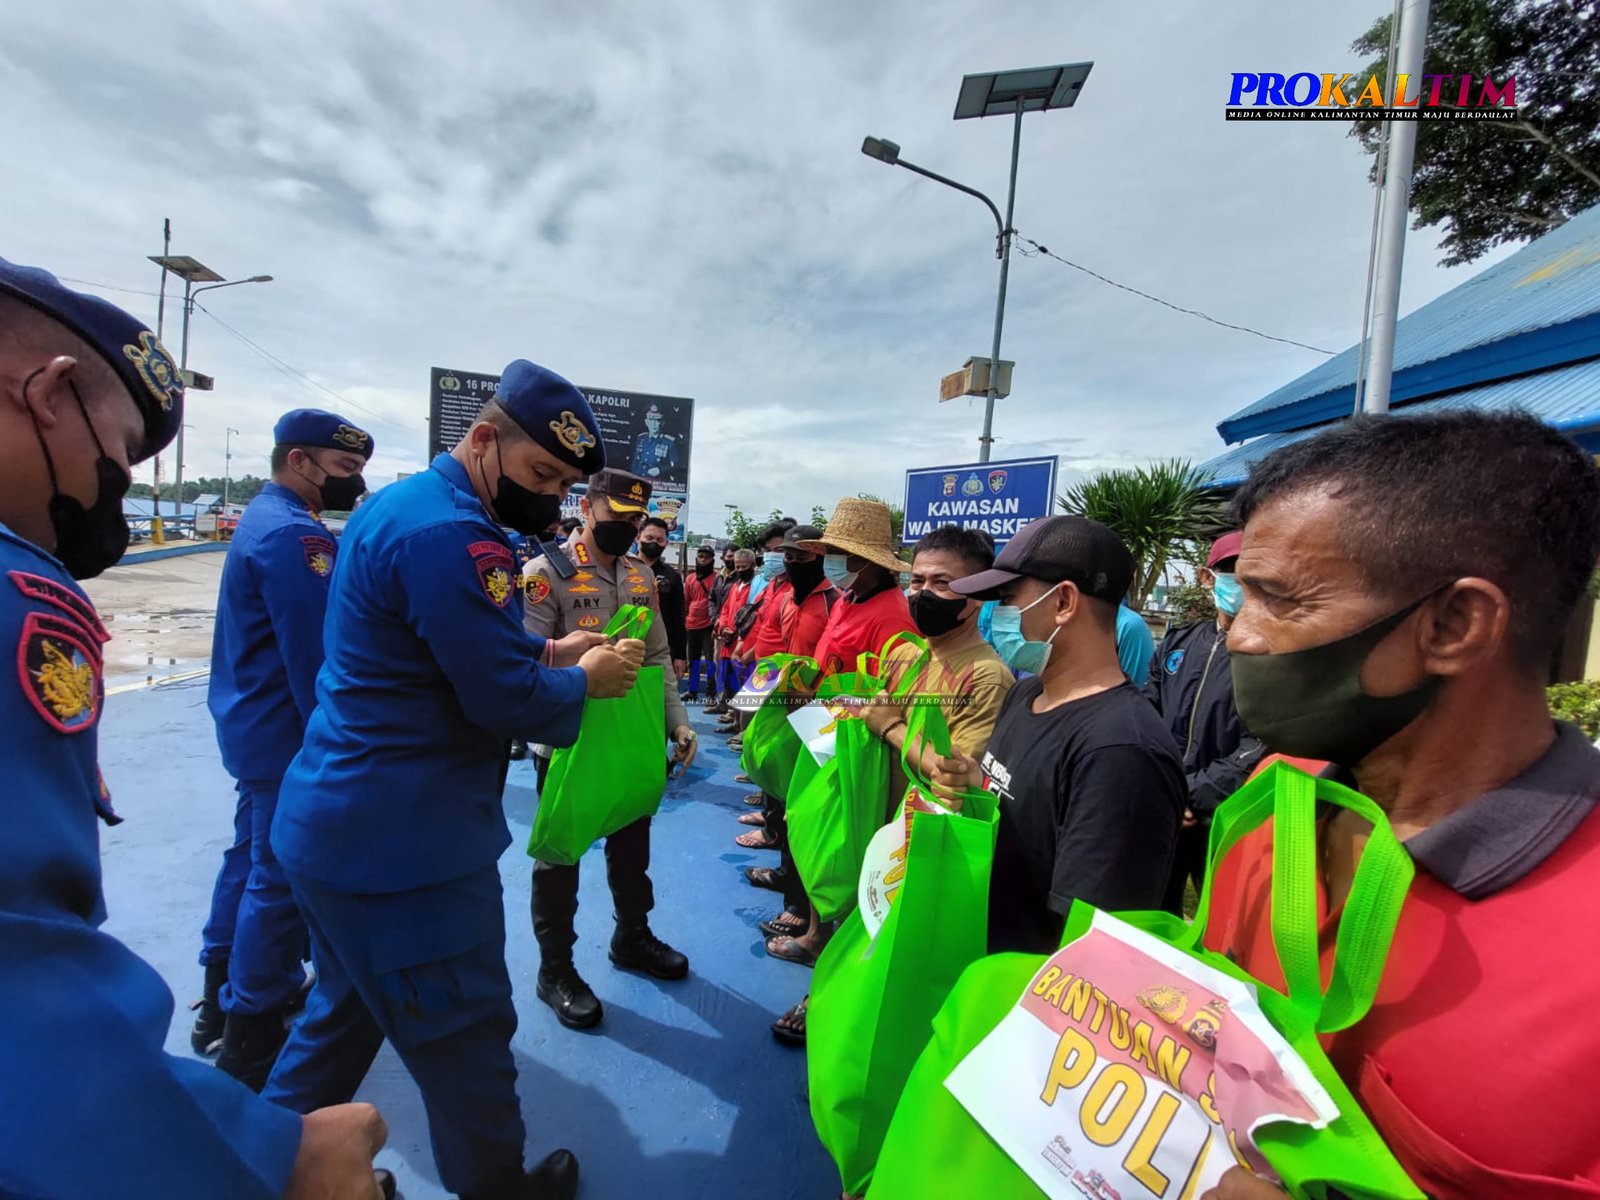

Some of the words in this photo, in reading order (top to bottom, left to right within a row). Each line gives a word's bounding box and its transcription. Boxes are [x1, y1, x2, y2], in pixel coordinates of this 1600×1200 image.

[466, 379, 478, 390] 16
[588, 393, 630, 408] KAPOLRI
[928, 498, 1019, 517] KAWASAN
[963, 517, 1038, 535] MASKE
[573, 598, 600, 609] ARY
[1032, 965, 1193, 1094] BANTUAN
